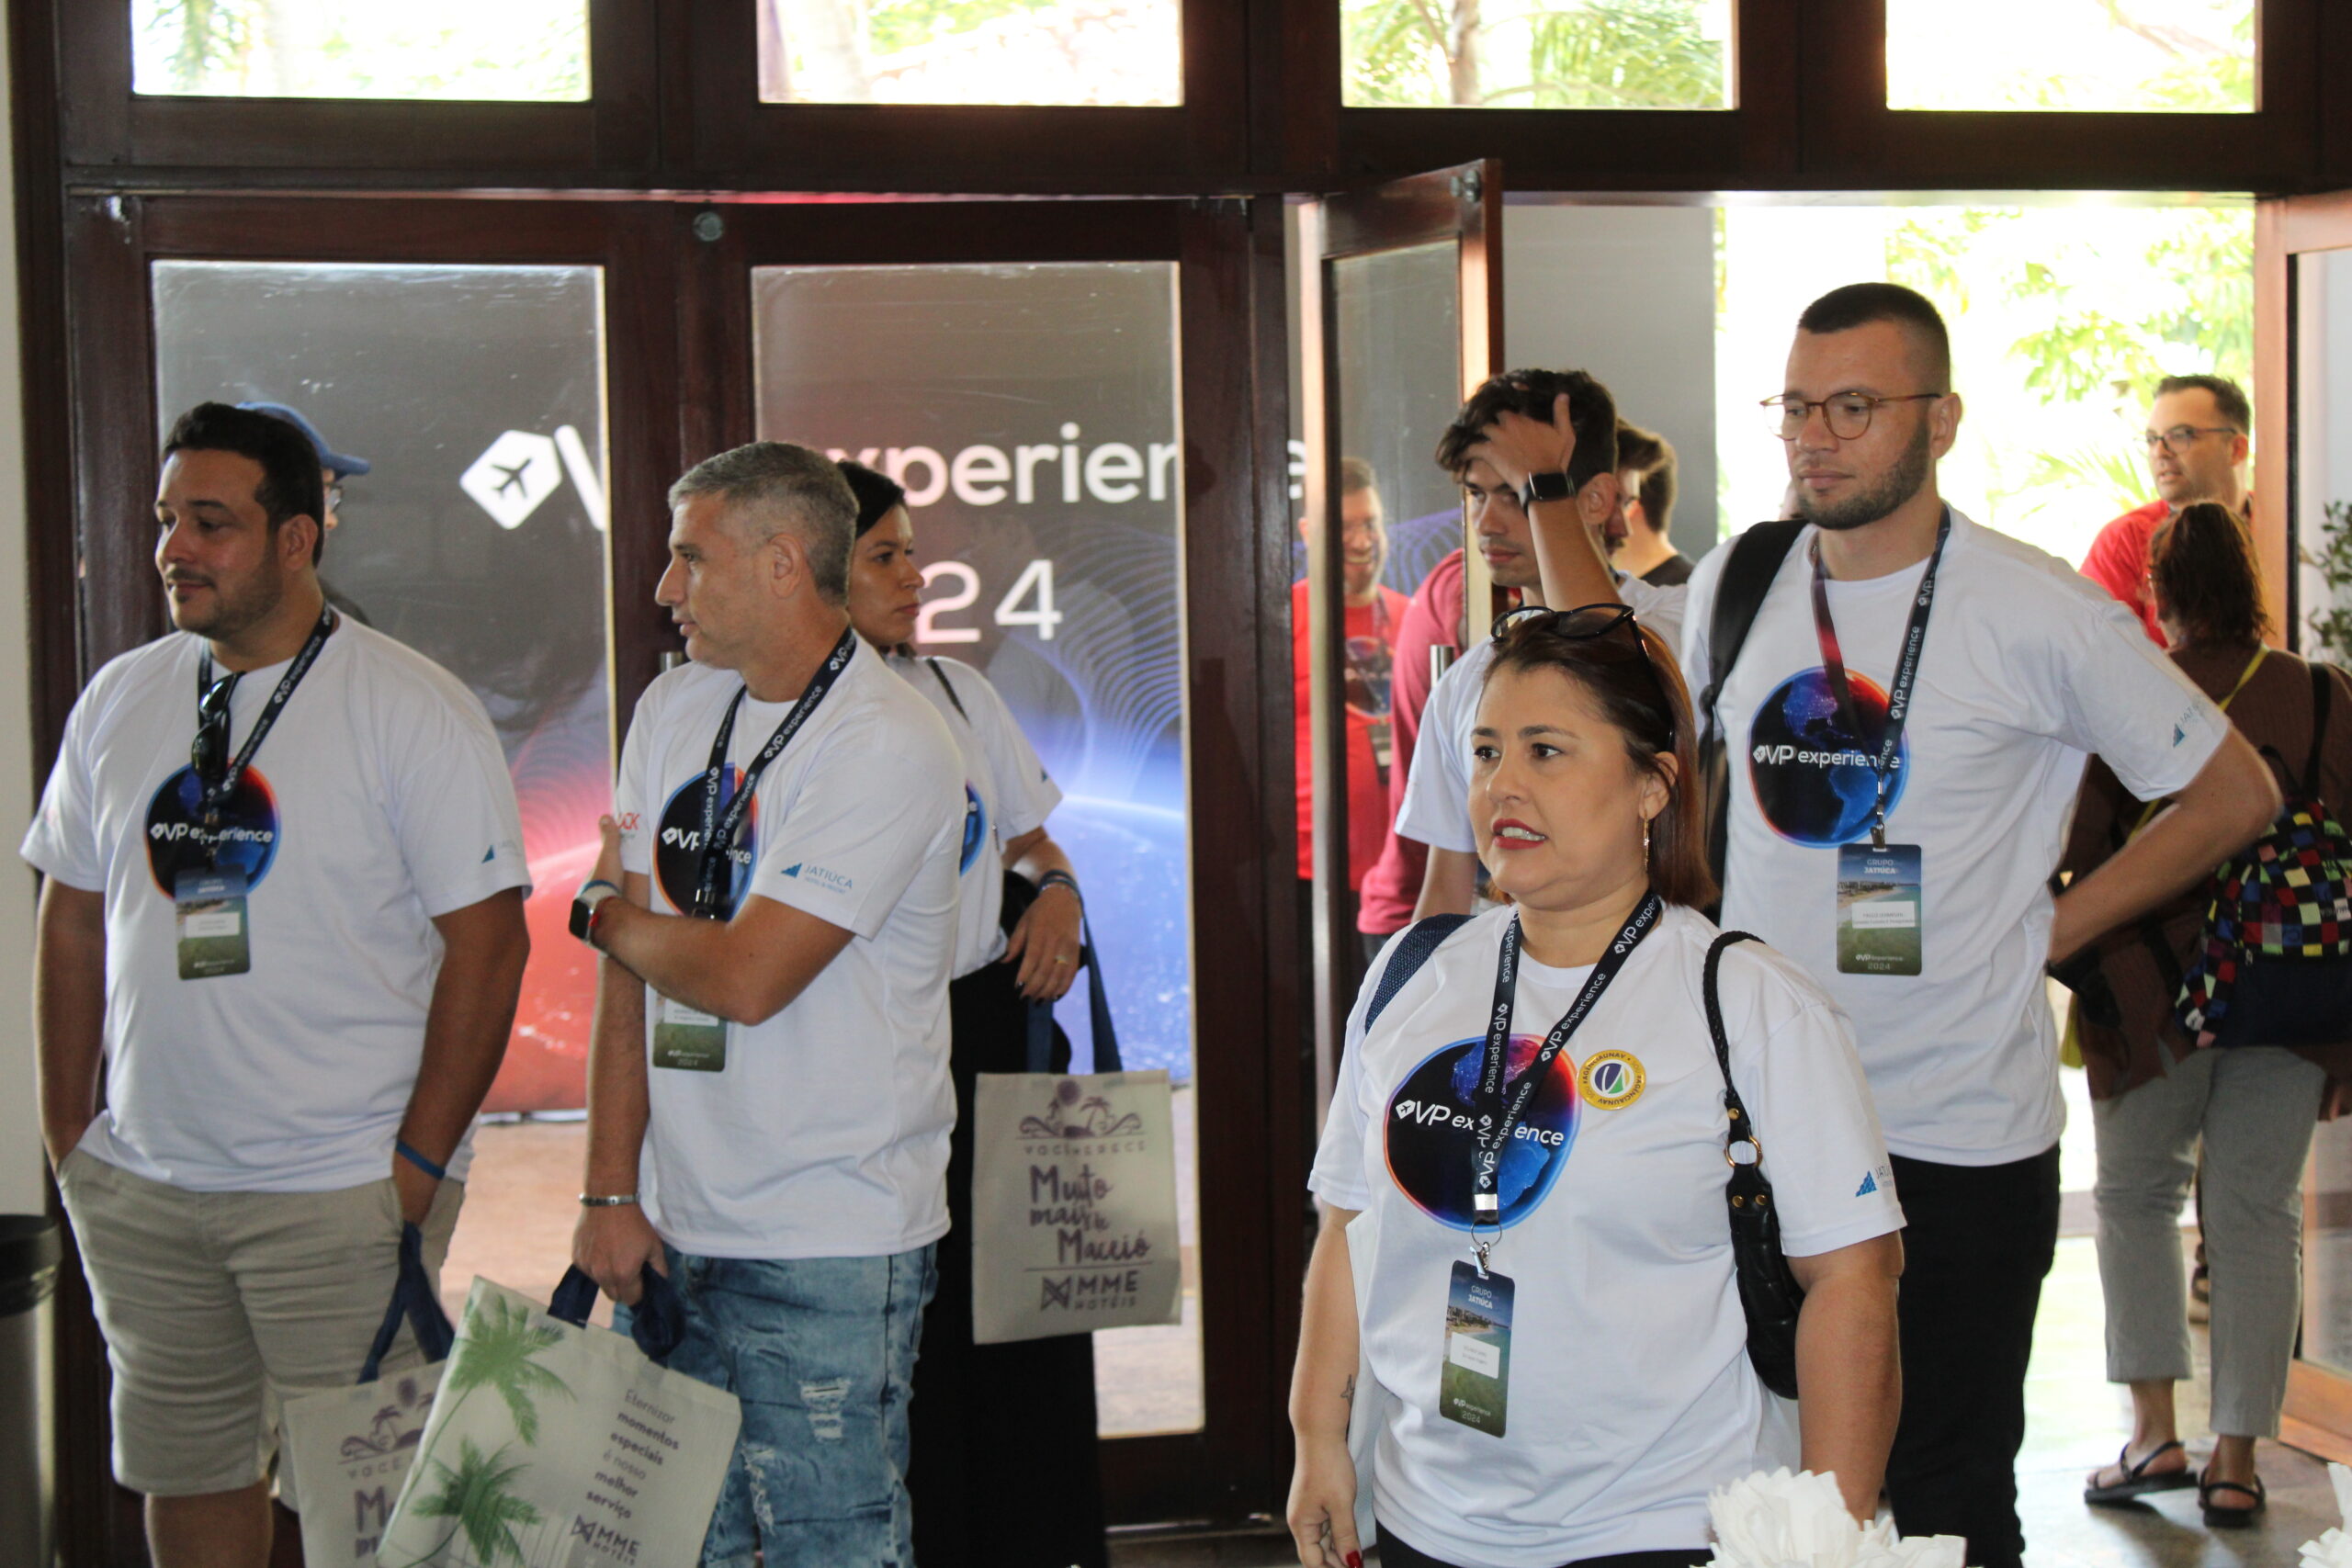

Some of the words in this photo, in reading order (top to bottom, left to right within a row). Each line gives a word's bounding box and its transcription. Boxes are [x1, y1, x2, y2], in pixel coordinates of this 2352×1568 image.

[916, 558, 1064, 644] 24
[1899, 626, 1920, 688] experience
[1894, 689, 1907, 709] VP
[770, 734, 785, 752] VP
[783, 685, 823, 736] experience
[1766, 745, 1795, 765] VP
[707, 773, 719, 795] VP
[724, 773, 755, 829] experience
[164, 822, 189, 841] VP
[1617, 926, 1637, 945] VP
[1501, 922, 1516, 983] experience
[1493, 1010, 1507, 1032] VP
[1544, 1031, 1563, 1052] VP
[1561, 973, 1607, 1030] experience
[1485, 1032, 1502, 1094] experience
[1416, 1100, 1452, 1126] VP
[1479, 1151, 1496, 1177] VP
[1492, 1081, 1532, 1150] experience
[1077, 1270, 1139, 1295] MME
[1471, 1285, 1492, 1299] GRUPO
[617, 1412, 679, 1450] momentos
[1462, 1410, 1481, 1424] 2024
[610, 1432, 663, 1466] especiais
[594, 1472, 639, 1498] melhor
[596, 1525, 640, 1558] MME
